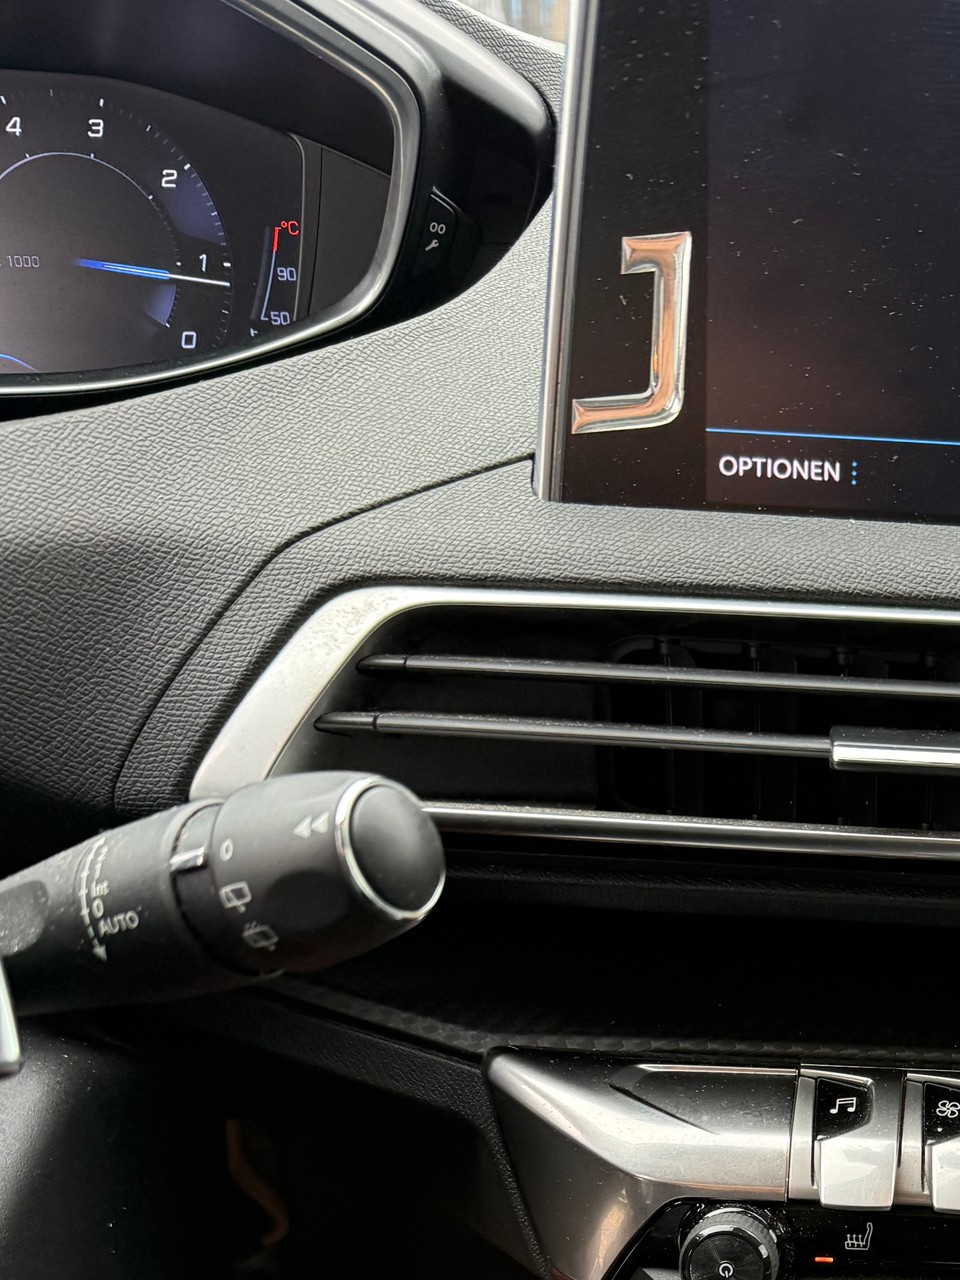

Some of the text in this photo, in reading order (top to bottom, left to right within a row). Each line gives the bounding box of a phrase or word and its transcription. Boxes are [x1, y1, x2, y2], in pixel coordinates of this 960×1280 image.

[6, 117, 22, 136] 4
[88, 118, 104, 137] 3
[161, 169, 178, 188] 2
[6, 255, 40, 268] 1000
[199, 254, 207, 272] 1
[277, 267, 297, 281] 90
[270, 311, 291, 325] 50
[181, 331, 197, 349] 0
[718, 455, 841, 482] OPTIONEN
[98, 910, 139, 937] AUTO
